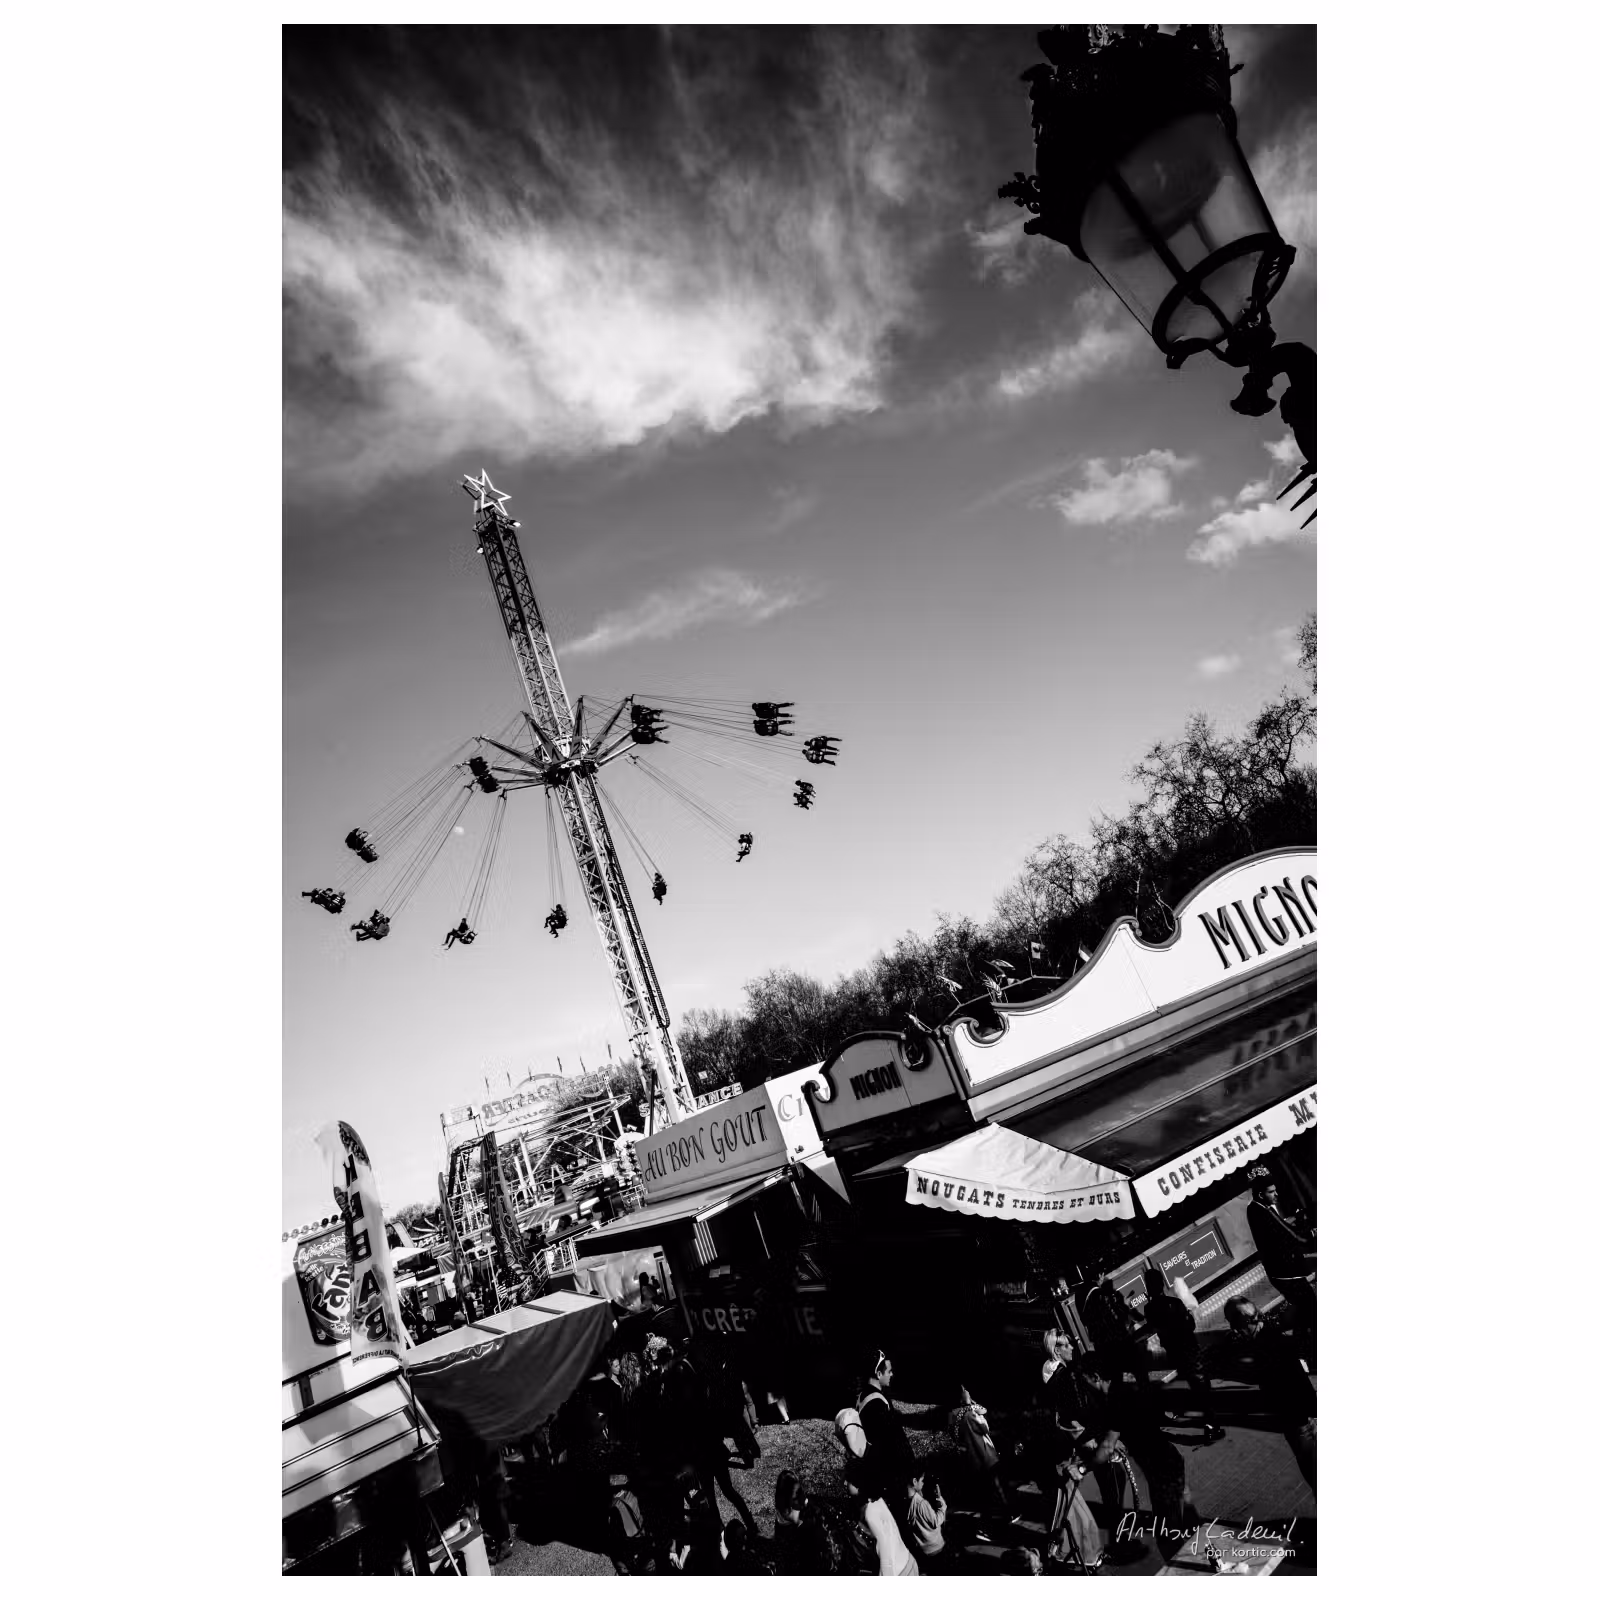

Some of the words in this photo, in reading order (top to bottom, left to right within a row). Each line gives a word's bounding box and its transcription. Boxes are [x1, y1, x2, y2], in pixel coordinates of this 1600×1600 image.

[849, 1061, 902, 1101] MIGNON
[643, 1147, 667, 1182] AU
[666, 1127, 704, 1172] BON
[710, 1105, 768, 1164] GOUT
[1157, 1123, 1268, 1196] CONFISERIE
[916, 1176, 1006, 1209] NOUGATS
[1012, 1198, 1065, 1211] TENDRES
[1069, 1197, 1084, 1209] ET
[1089, 1191, 1121, 1206] DURS
[1163, 1251, 1188, 1271] SAVEURS
[1185, 1258, 1191, 1267] ET
[1190, 1249, 1217, 1270] TRADITION
